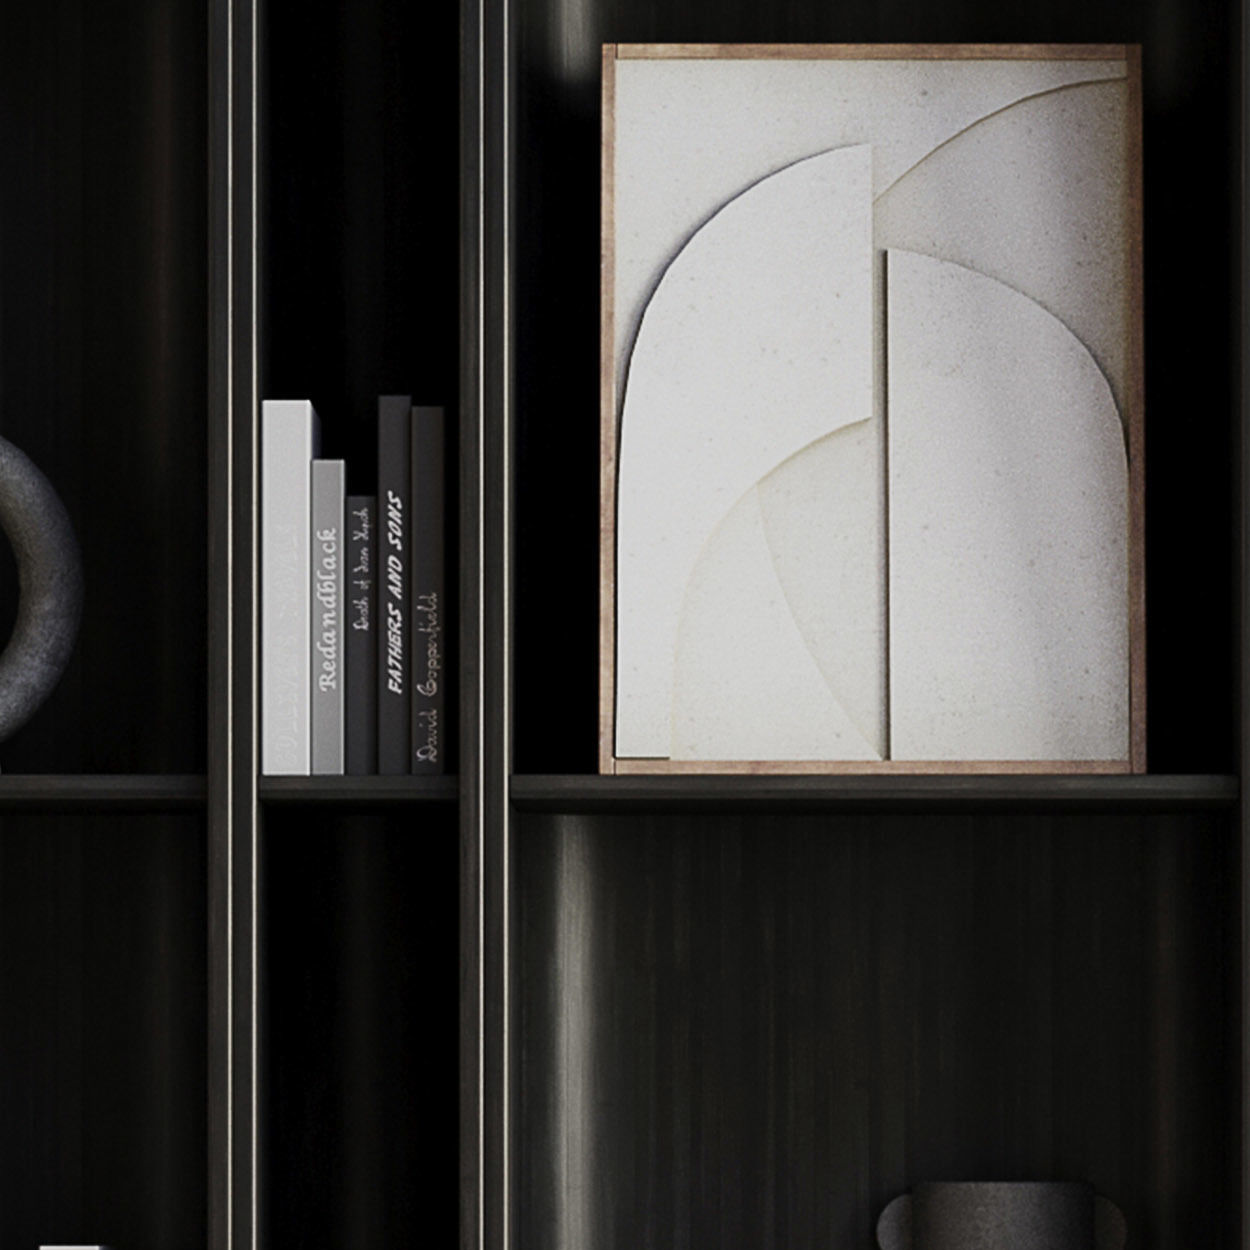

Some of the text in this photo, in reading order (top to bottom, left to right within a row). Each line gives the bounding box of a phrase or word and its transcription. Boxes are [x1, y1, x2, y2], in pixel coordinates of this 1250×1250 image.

[316, 527, 337, 691] Redandblack
[388, 491, 402, 694] FATHERS AND SONS
